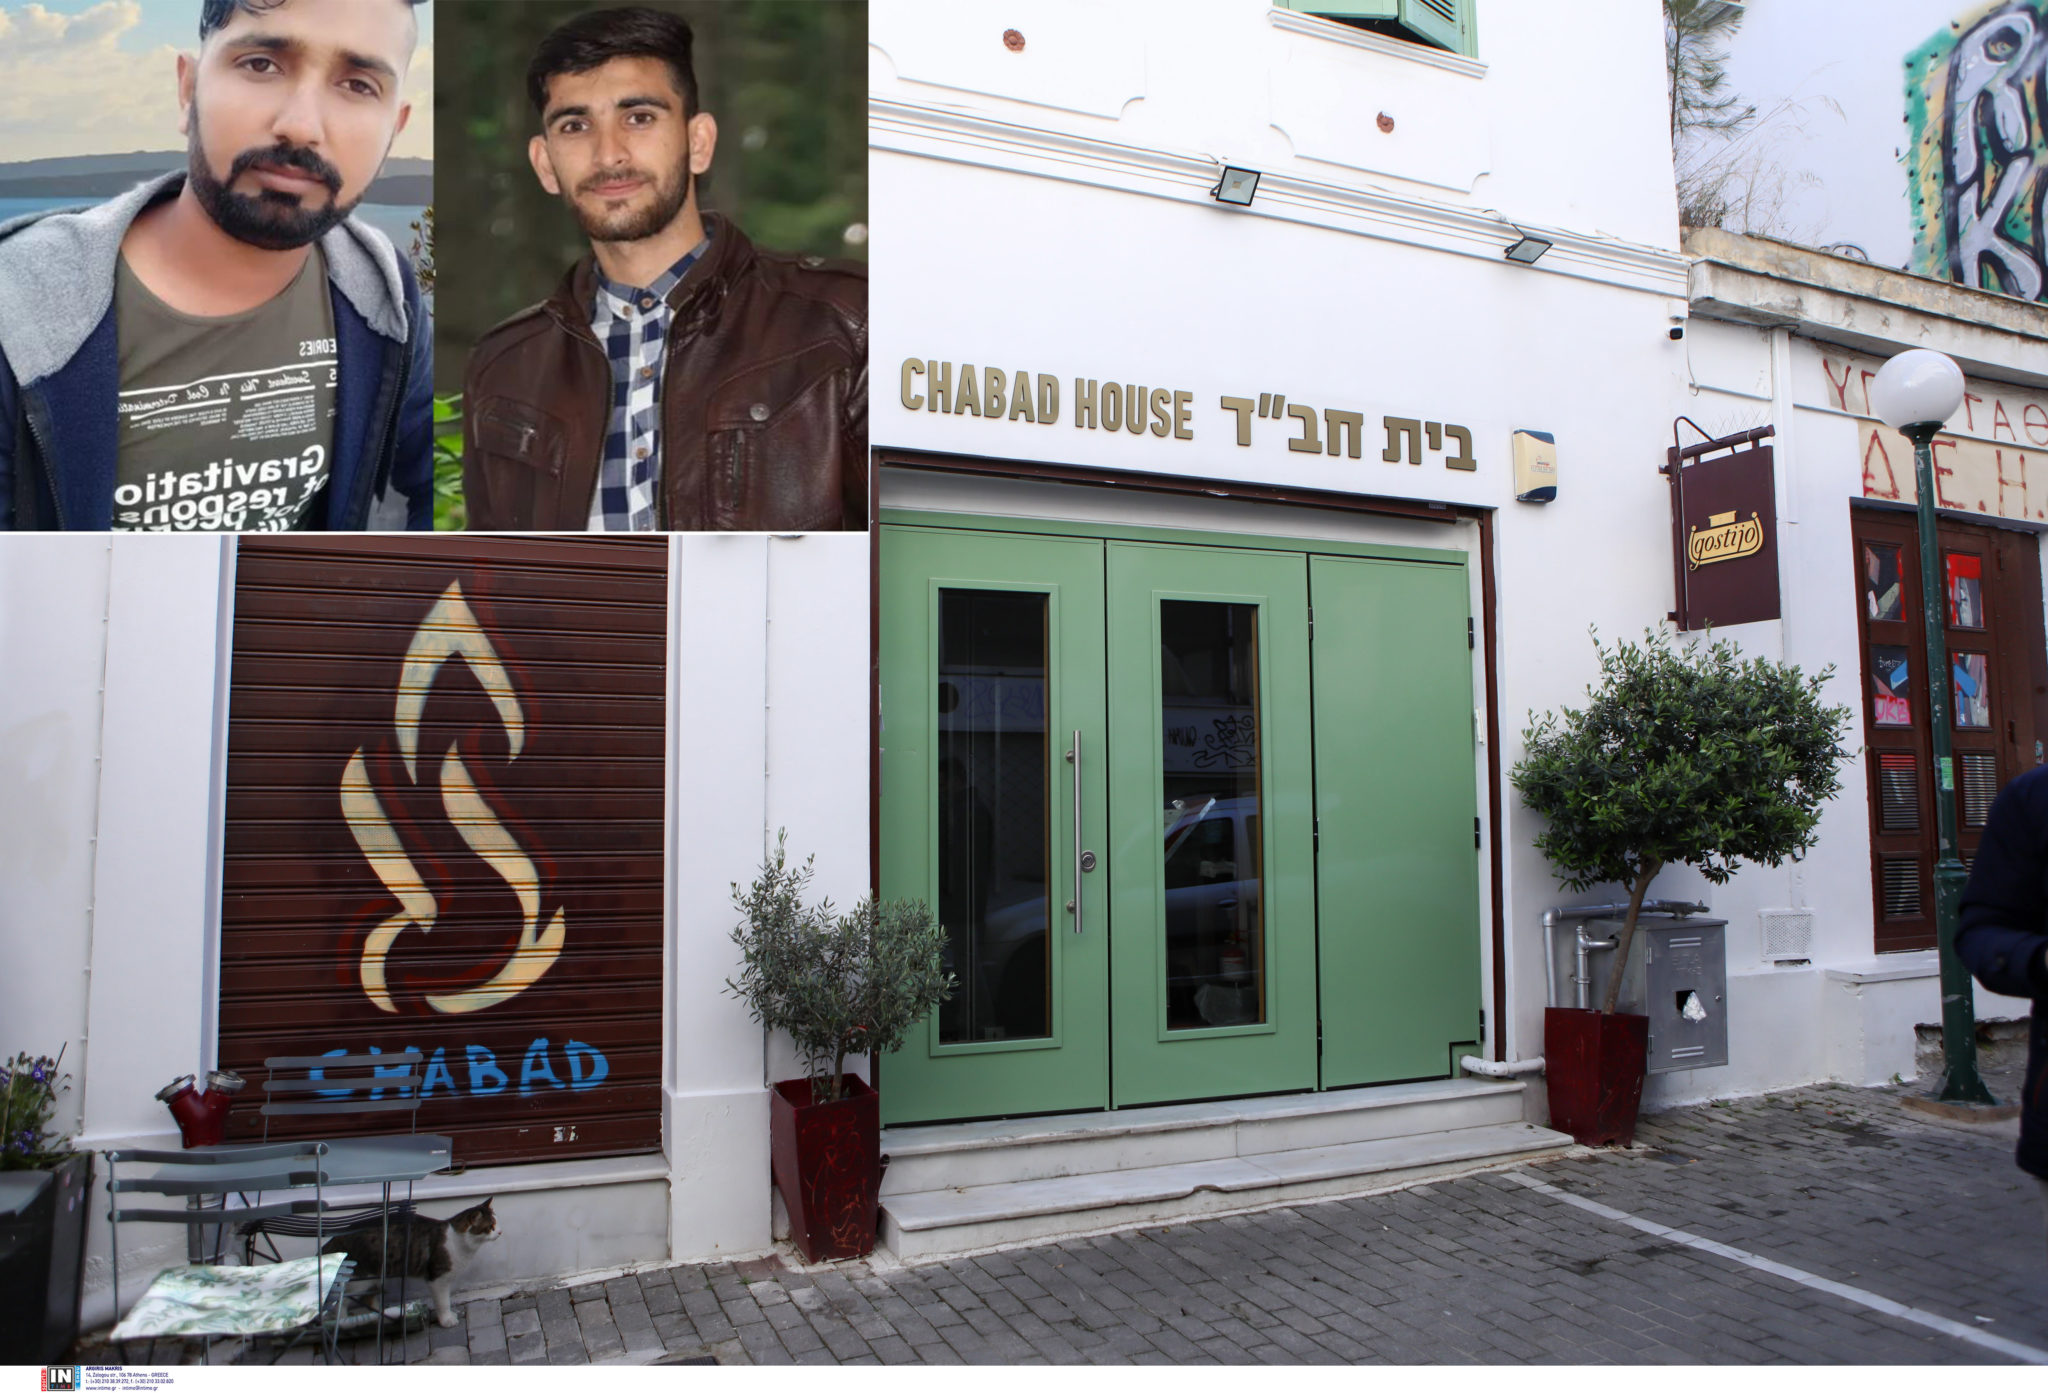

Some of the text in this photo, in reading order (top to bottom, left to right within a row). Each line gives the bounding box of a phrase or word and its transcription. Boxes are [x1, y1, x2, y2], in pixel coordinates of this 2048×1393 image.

[899, 356, 1194, 440] CHABAD HOUSE
[1382, 415, 1477, 472] בית
[1689, 523, 1757, 571] gostijo
[308, 1037, 610, 1099] CHABAD
